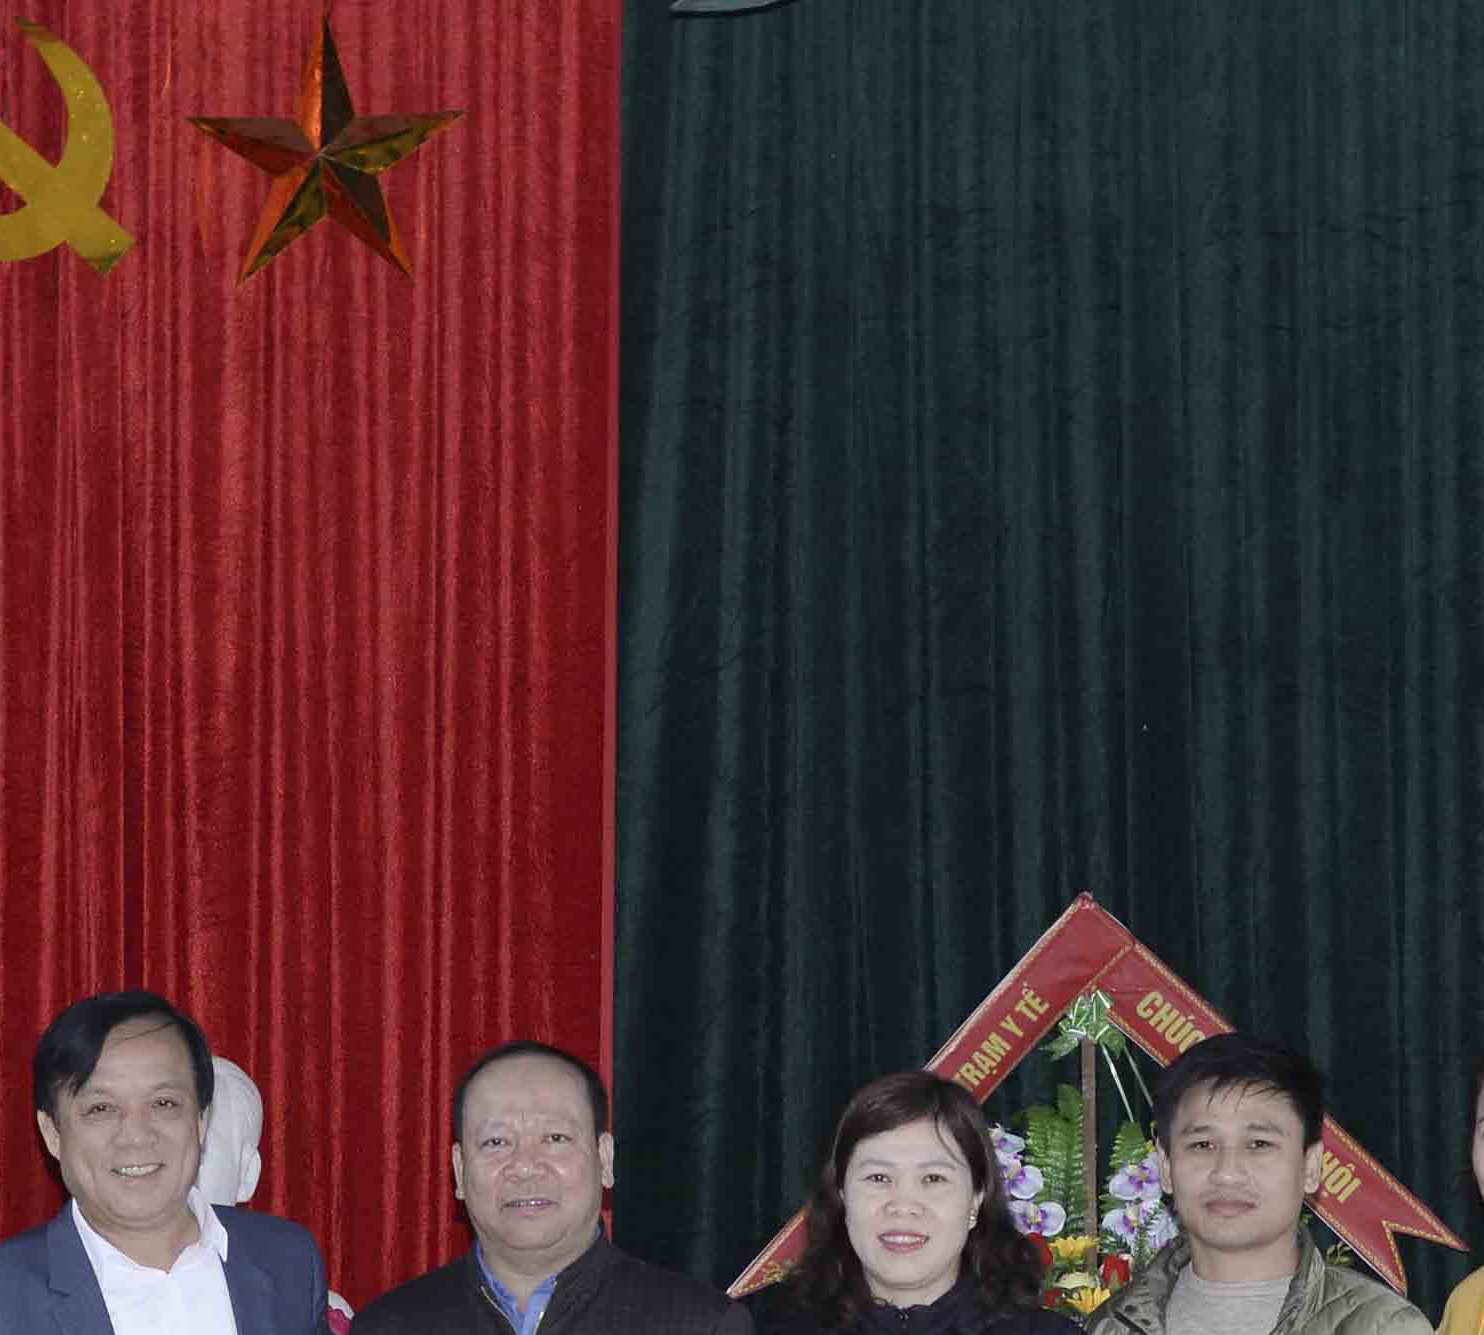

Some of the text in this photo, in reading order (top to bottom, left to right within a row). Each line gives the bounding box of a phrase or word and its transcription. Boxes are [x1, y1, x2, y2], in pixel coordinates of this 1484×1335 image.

[951, 981, 1050, 1092] TRẠM Y TẾ
